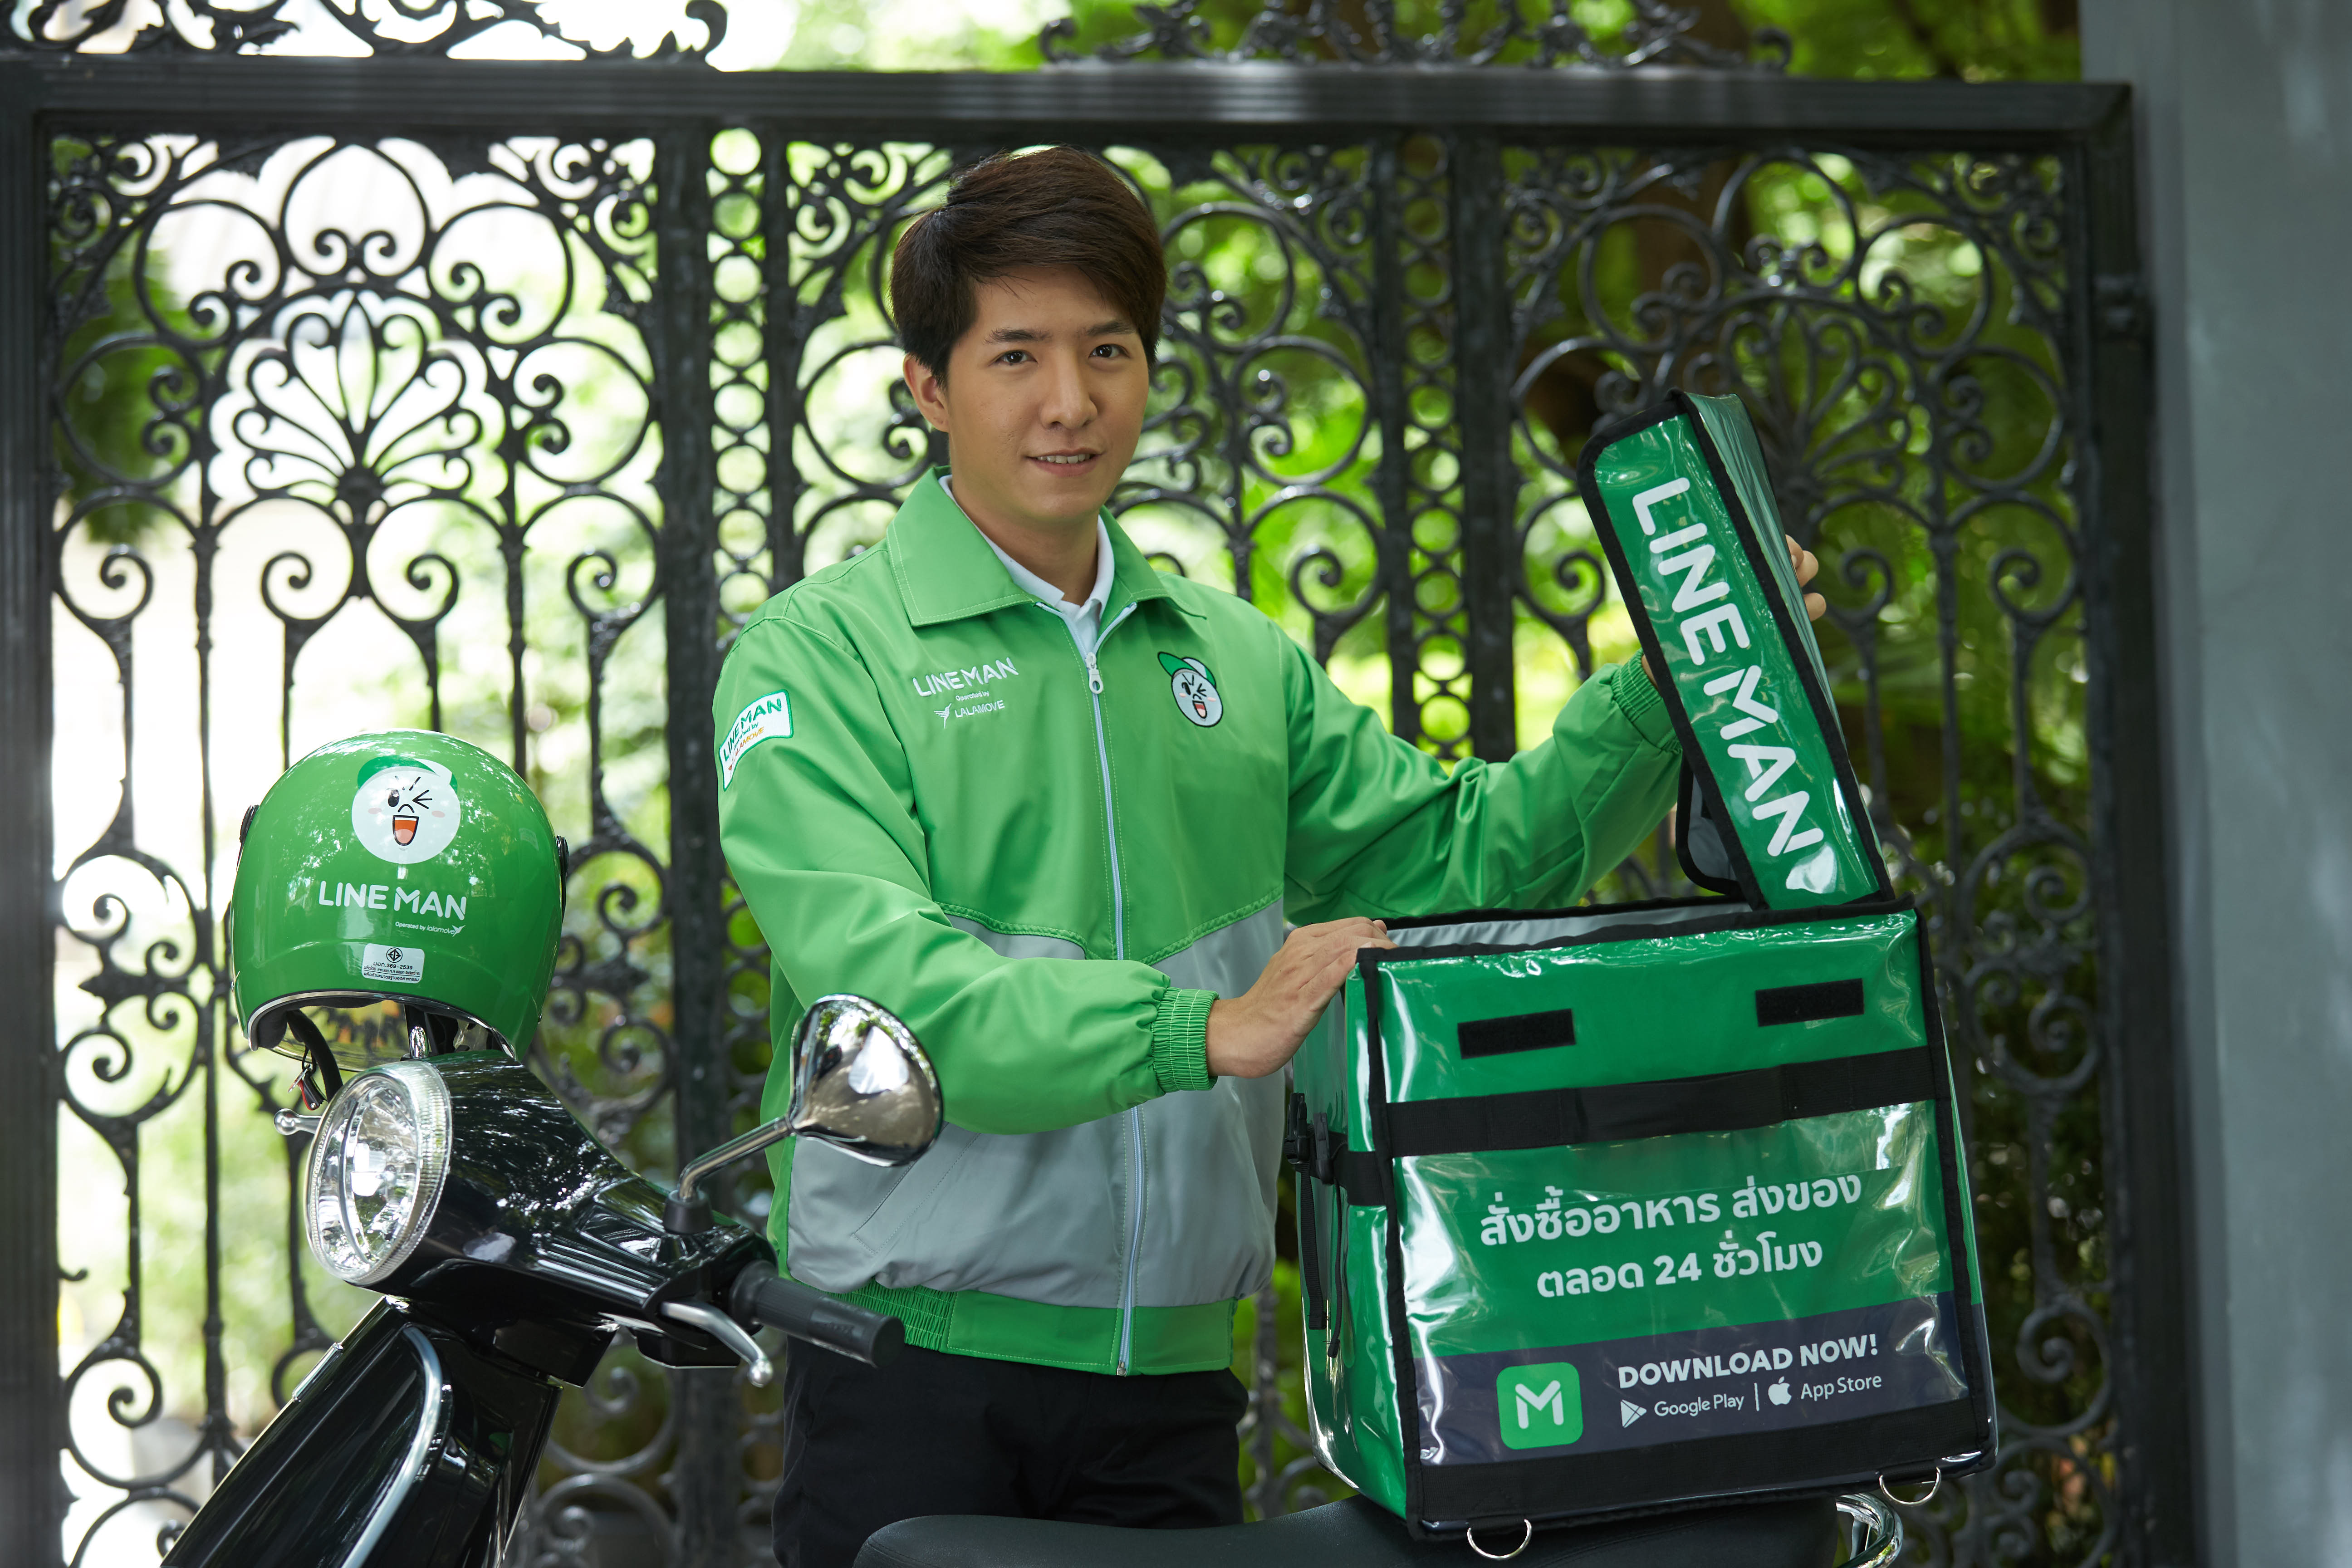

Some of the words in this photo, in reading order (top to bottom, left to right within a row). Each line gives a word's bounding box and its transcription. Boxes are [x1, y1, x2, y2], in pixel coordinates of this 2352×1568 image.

[912, 671, 965, 697] LINE
[960, 657, 1019, 686] MAN
[1633, 477, 1750, 666] LINE
[1703, 665, 1824, 857] MAN
[954, 700, 1005, 718] LALAMOVE
[955, 691, 982, 701] Operated
[724, 723, 739, 762] LINE
[740, 698, 782, 730] MAN
[319, 881, 389, 910] LINE
[394, 887, 467, 921] MAN
[395, 921, 419, 930] Operated
[426, 925, 455, 935] lalamove
[1480, 1185, 1720, 1246] สั่งซื้ออาหาร
[1732, 1174, 1862, 1218] ส่งของ
[1537, 1262, 1644, 1298] ตลอด
[1652, 1252, 1702, 1286] 24
[1713, 1230, 1823, 1278] ชั่วโมง
[1618, 1348, 1793, 1388] DOWNLOAD
[1799, 1333, 1878, 1367] NOW!
[1515, 1380, 1564, 1430] M
[1654, 1396, 1710, 1416] Google
[1713, 1393, 1744, 1410] Play
[1800, 1382, 1834, 1401] App
[1837, 1375, 1882, 1393] Store
